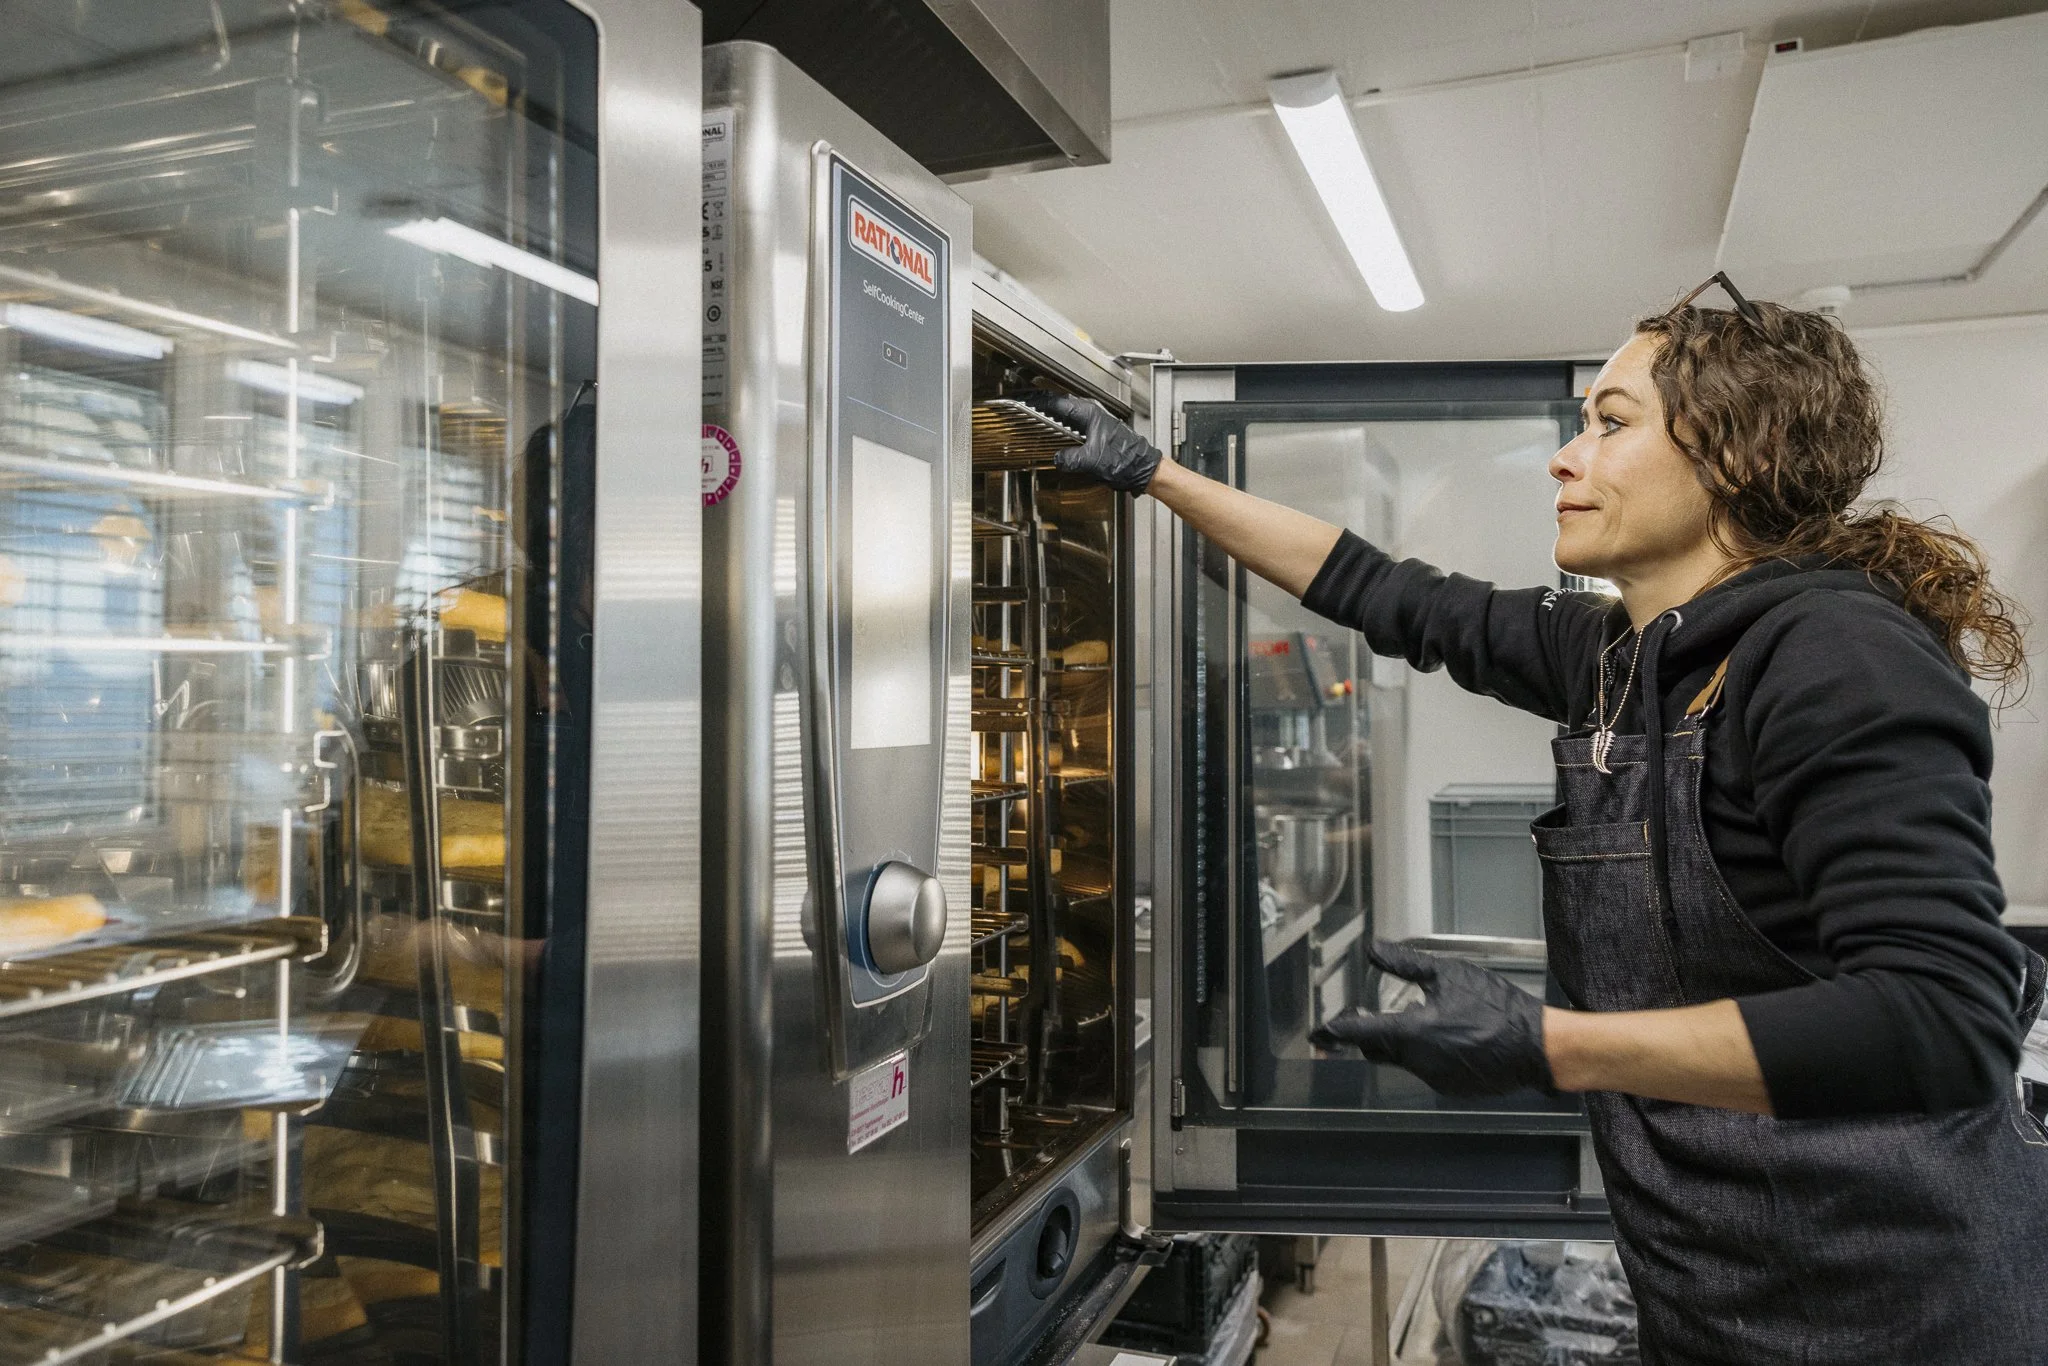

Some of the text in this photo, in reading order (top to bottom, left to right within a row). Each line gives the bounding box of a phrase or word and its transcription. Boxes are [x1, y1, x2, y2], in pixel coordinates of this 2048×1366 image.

[702, 127, 722, 136] NAL
[855, 211, 932, 285] RATIONAL
[863, 280, 925, 325] SelfCookingCenter
